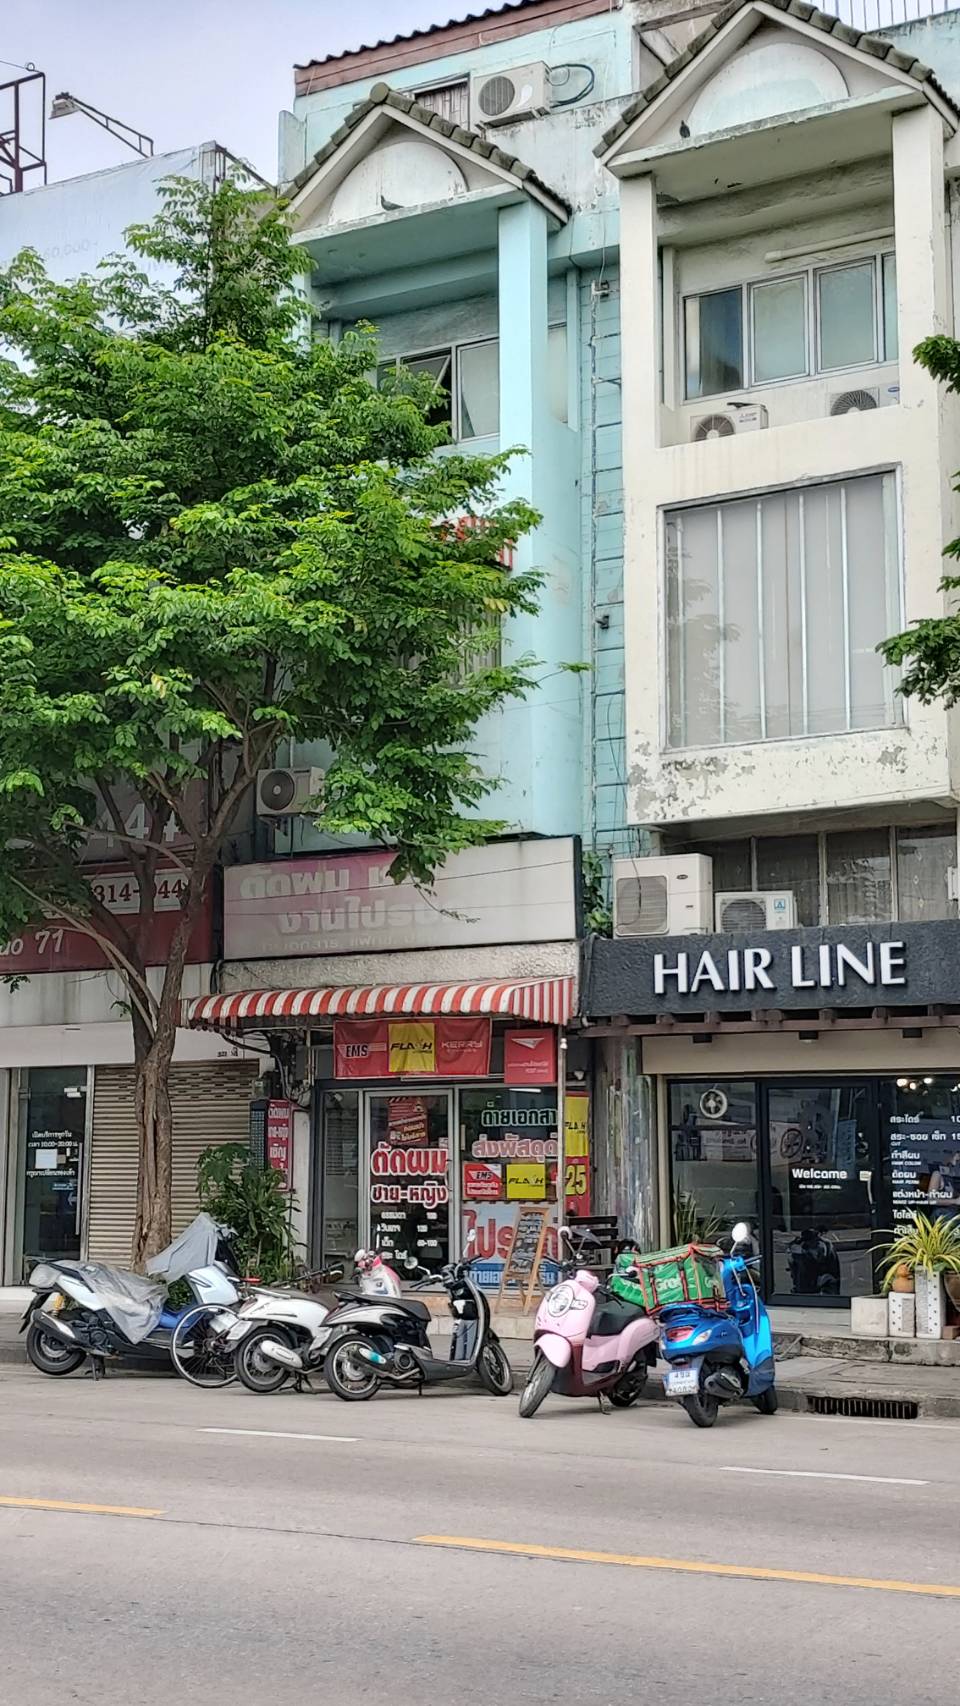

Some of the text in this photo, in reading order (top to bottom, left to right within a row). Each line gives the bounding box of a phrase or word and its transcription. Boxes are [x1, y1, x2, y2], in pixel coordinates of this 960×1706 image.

[34, 928, 64, 954] 71
[653, 940, 906, 995] HAIR LINE
[345, 1043, 369, 1058] EMS
[441, 1039, 484, 1049] KERRY
[481, 1101, 558, 1127] ถ่ายเอกสา
[370, 1141, 449, 1176] ตัดผม
[471, 1132, 558, 1163] ส่งพัสดุด่
[565, 1164, 588, 1196] 25
[791, 1167, 848, 1180] Welcome
[370, 1180, 449, 1209] ชาย-หญิง
